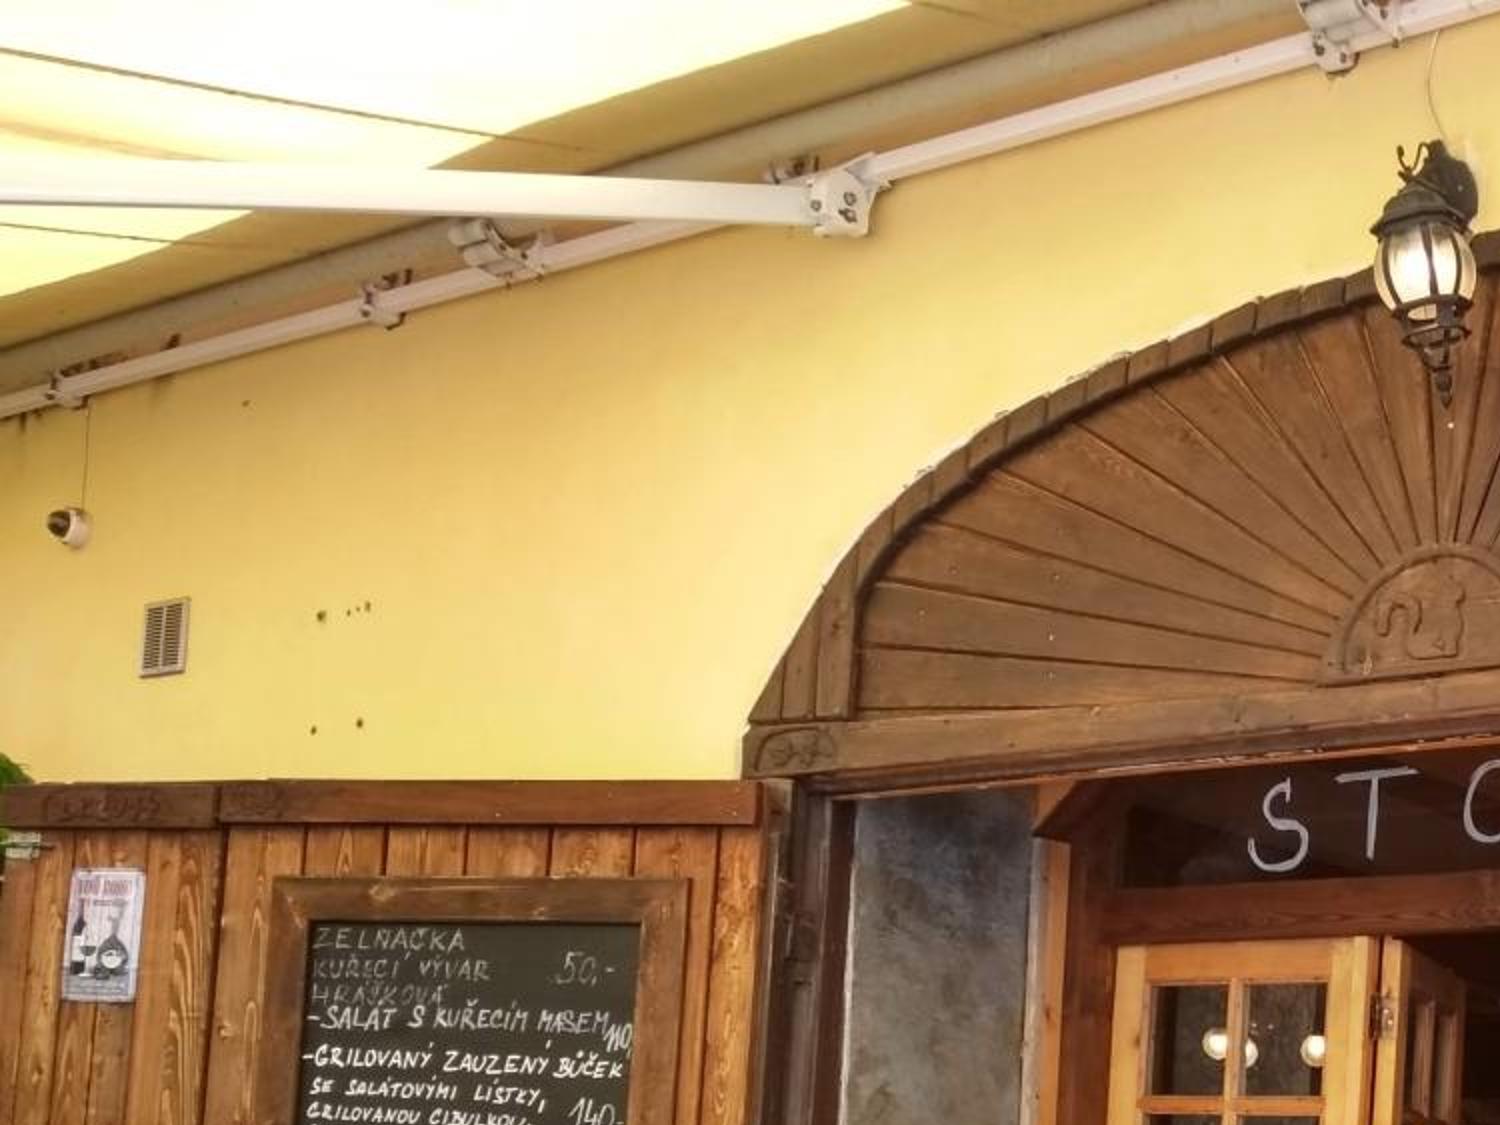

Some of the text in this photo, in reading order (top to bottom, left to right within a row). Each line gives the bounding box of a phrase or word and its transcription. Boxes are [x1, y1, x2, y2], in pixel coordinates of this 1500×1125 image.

[419, 956, 492, 980] VÝVAR
[407, 1007, 424, 1028] S
[434, 998, 529, 1031] KUŘECÍM
[538, 1010, 609, 1035] MASEM
[552, 1050, 623, 1079] BŮČEK
[310, 1077, 334, 1095] SE
[307, 1103, 421, 1125] GRILOVANOU
